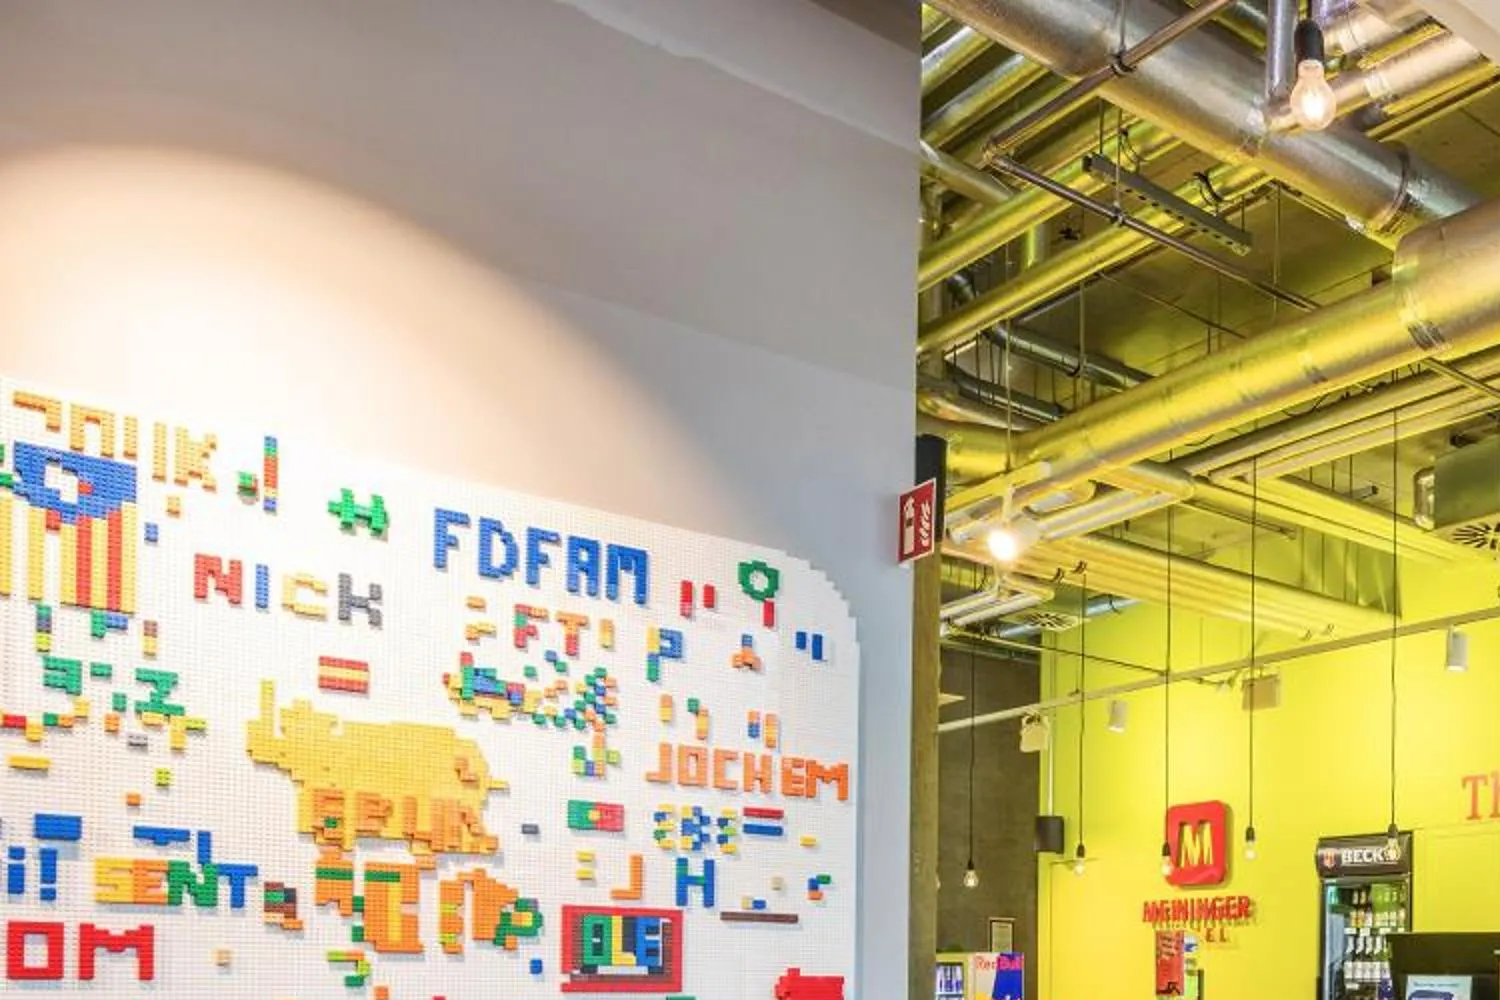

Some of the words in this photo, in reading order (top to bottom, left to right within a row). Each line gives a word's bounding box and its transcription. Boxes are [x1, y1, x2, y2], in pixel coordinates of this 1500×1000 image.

[645, 743, 849, 801] JOCHEM
[1341, 845, 1399, 864] BECK
[1142, 895, 1250, 923] MEININGER
[583, 914, 662, 966] OLE
